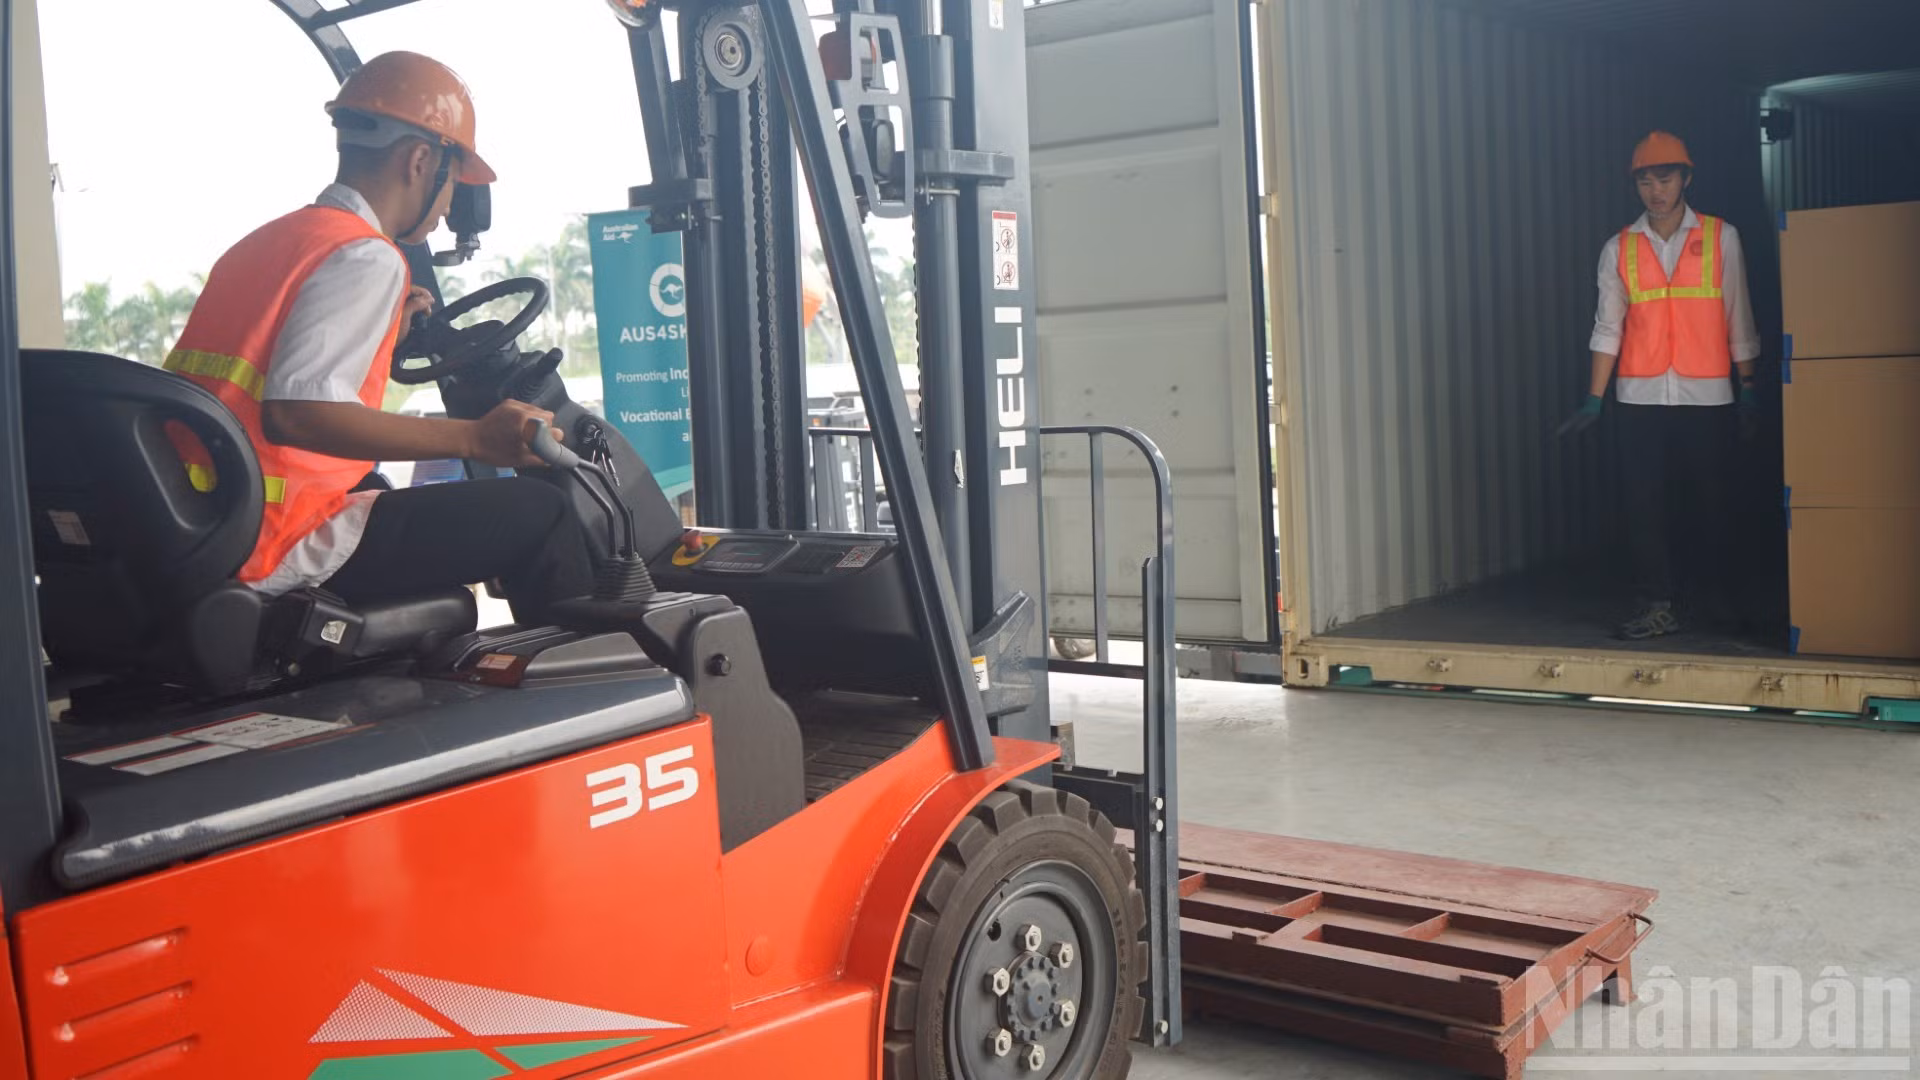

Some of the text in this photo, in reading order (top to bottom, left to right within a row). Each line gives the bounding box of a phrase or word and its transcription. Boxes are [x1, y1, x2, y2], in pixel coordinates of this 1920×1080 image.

[616, 371, 668, 383] Promoting
[995, 307, 1027, 486] HELI
[620, 408, 682, 423] Vocational
[586, 744, 698, 829] 35
